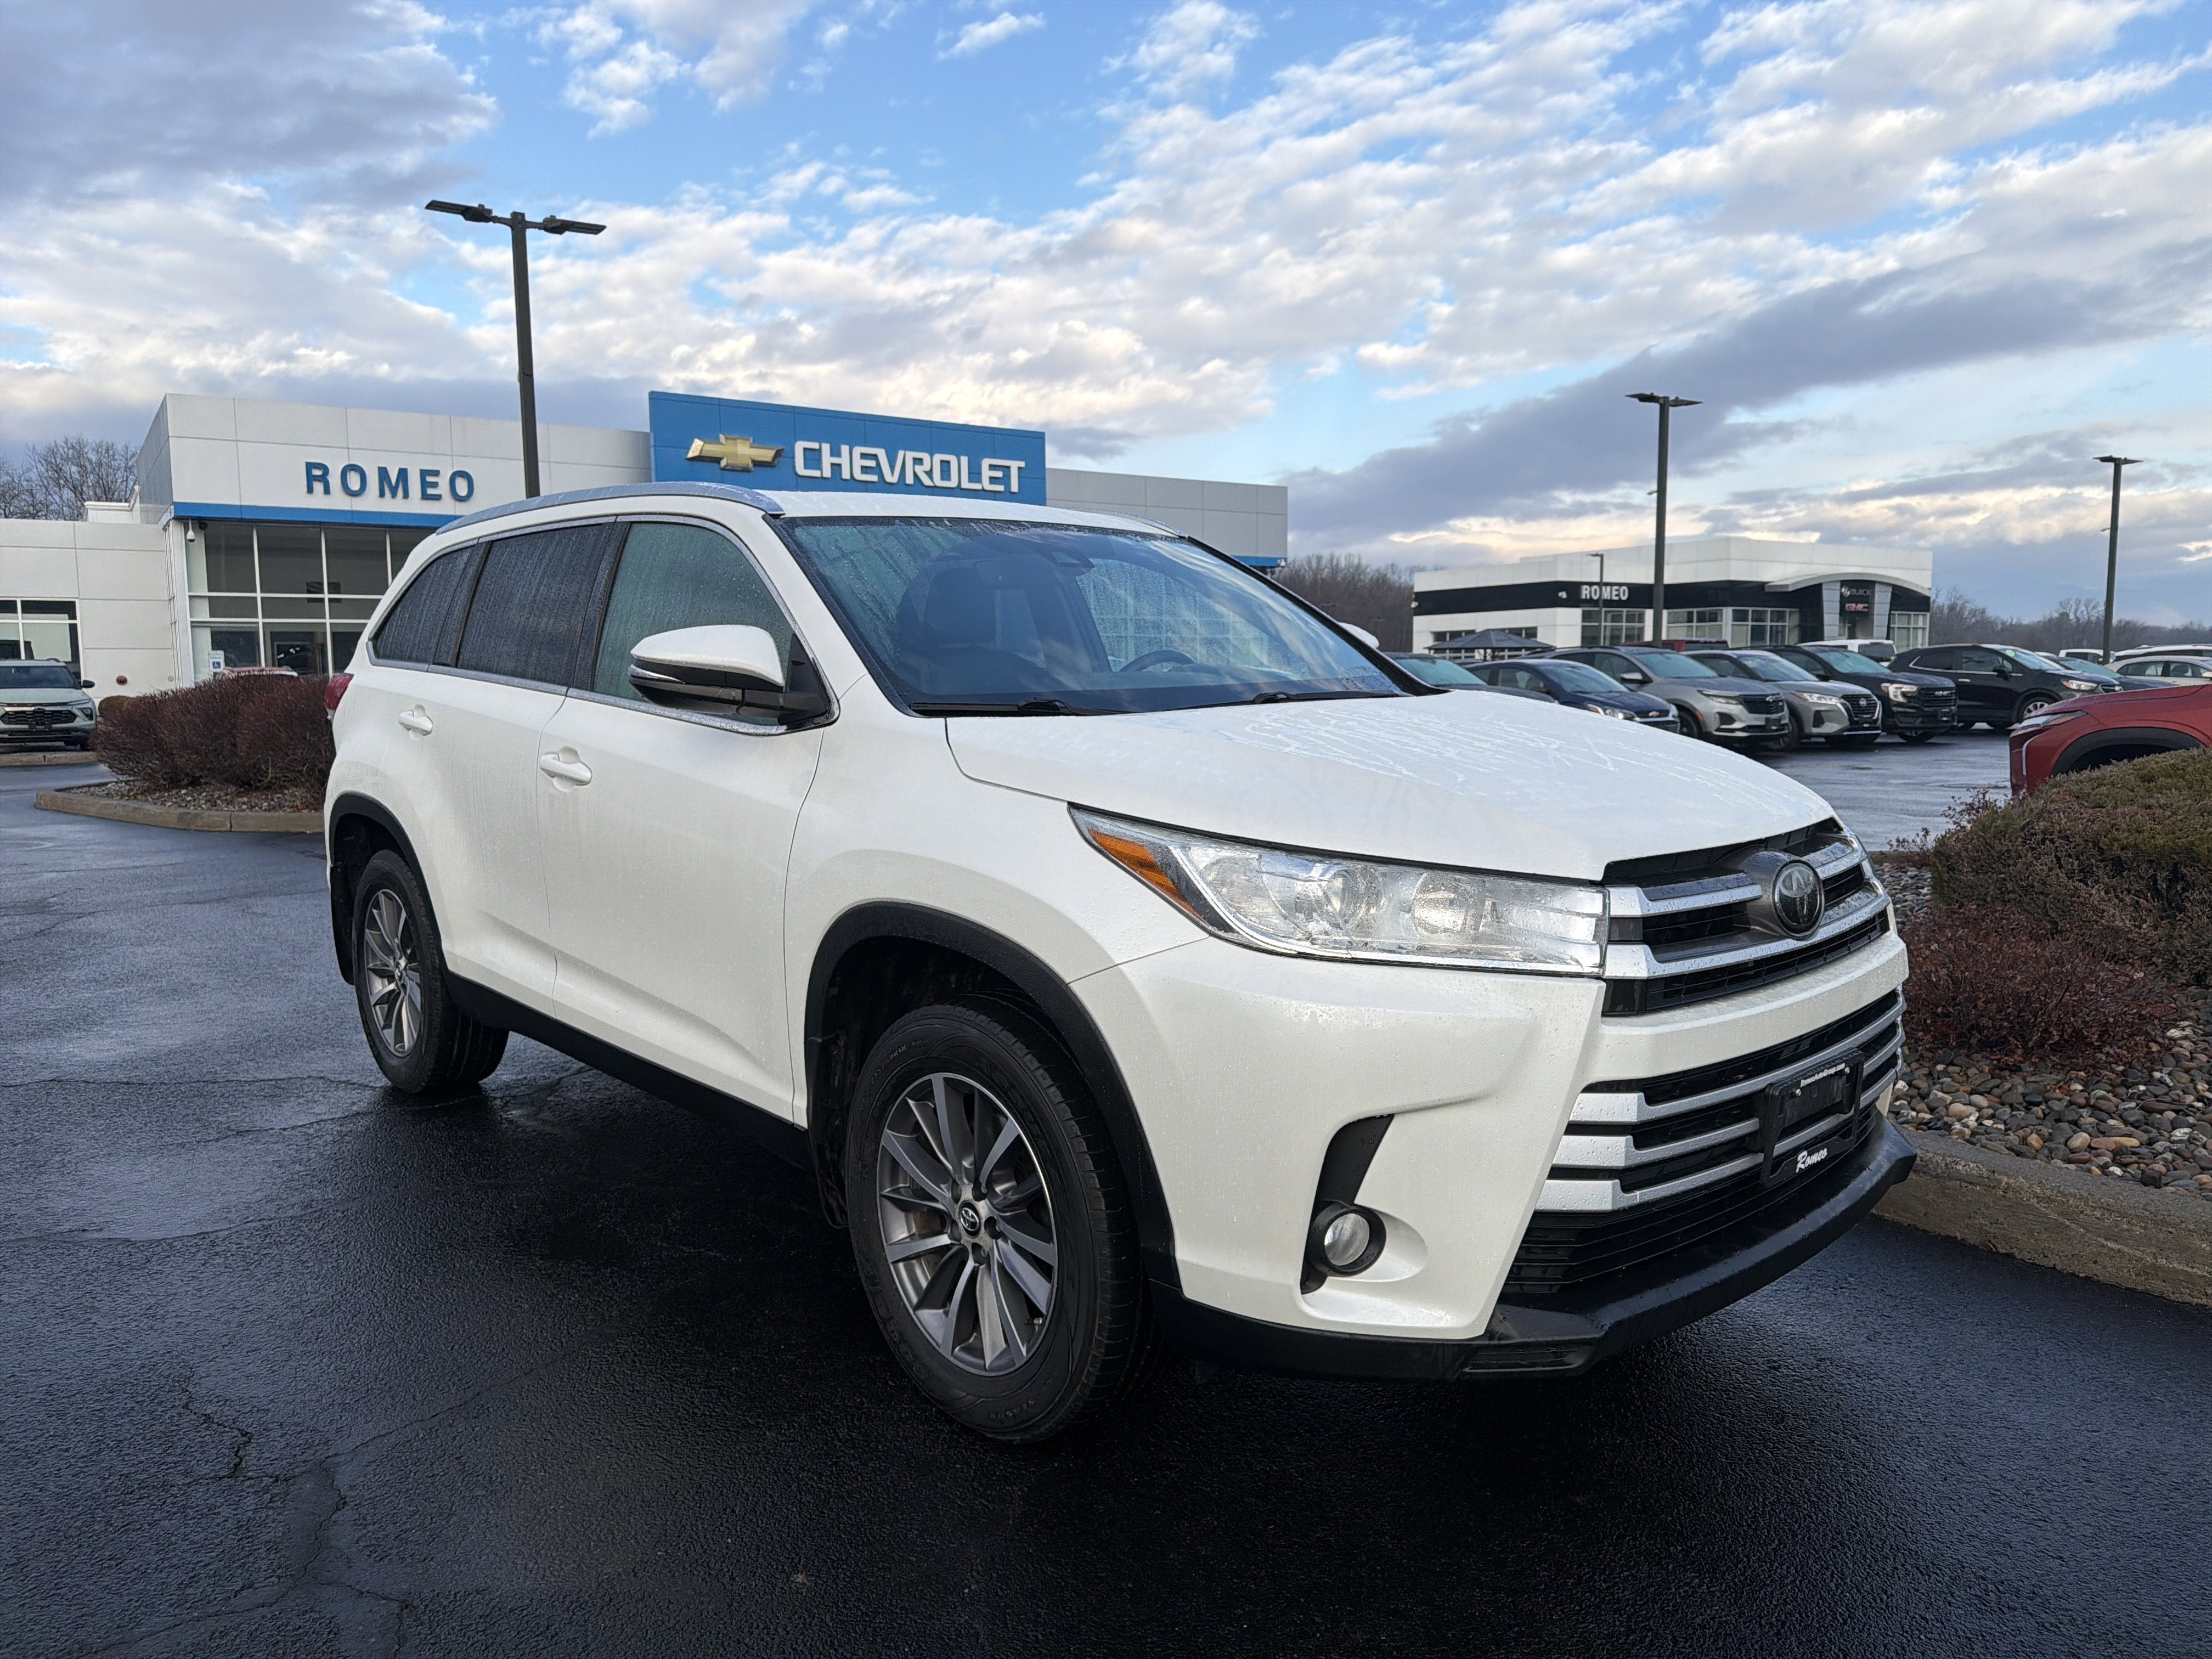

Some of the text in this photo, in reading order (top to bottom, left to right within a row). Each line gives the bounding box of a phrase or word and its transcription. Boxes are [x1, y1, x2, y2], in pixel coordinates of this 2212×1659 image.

[305, 461, 475, 502] ROMEO
[794, 441, 1025, 493] CHEVROLET
[1581, 585, 1629, 601] ROMEO
[1796, 1148, 1828, 1173] Romeo
